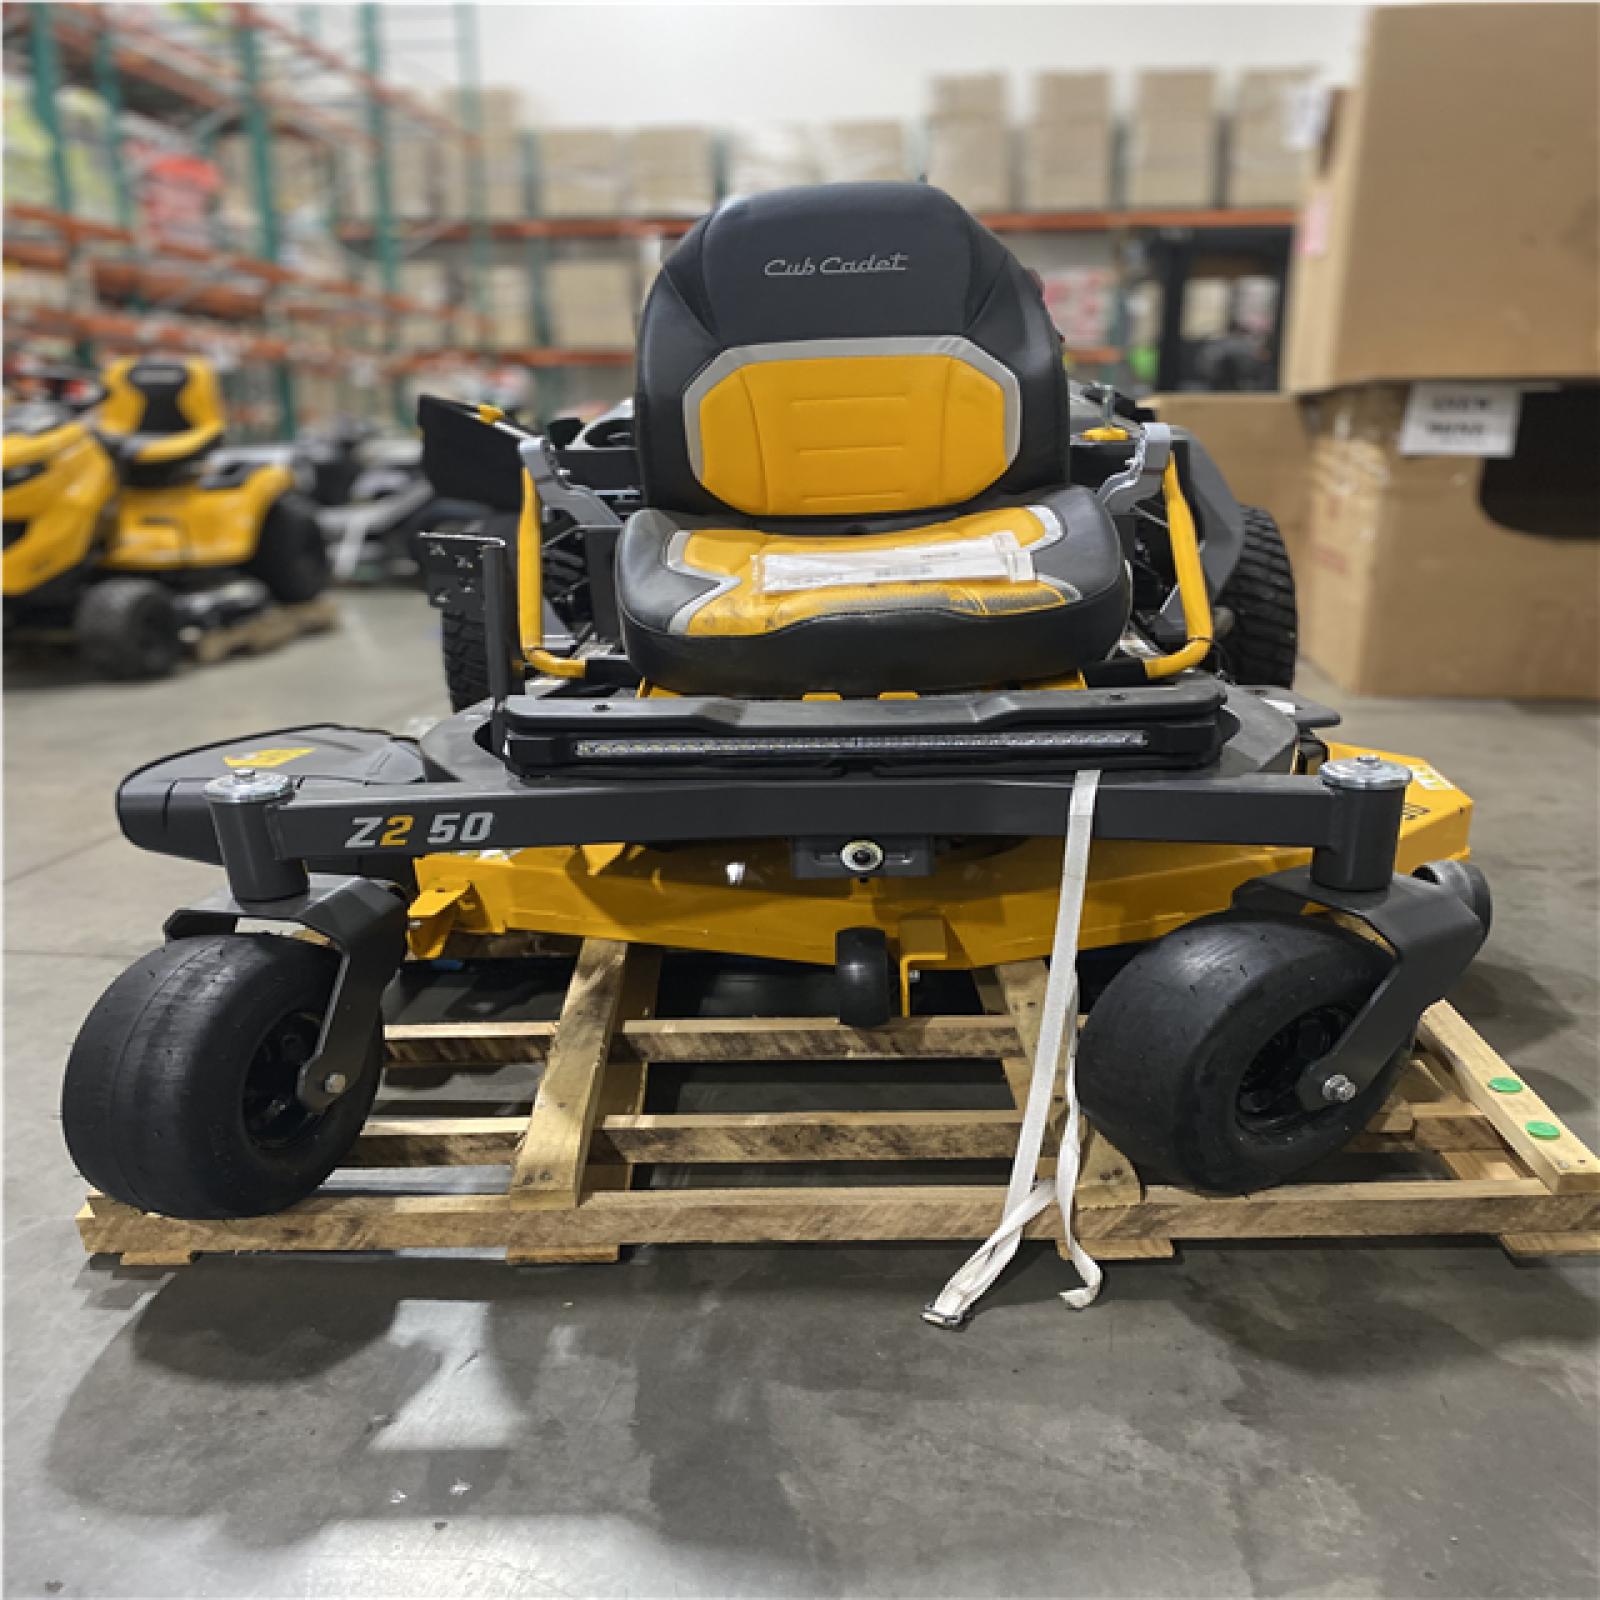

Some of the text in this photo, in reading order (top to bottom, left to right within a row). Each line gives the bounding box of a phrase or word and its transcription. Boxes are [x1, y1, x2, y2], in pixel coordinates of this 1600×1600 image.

[764, 252, 909, 276] Cub Cadet
[344, 811, 494, 849] Z2 50
